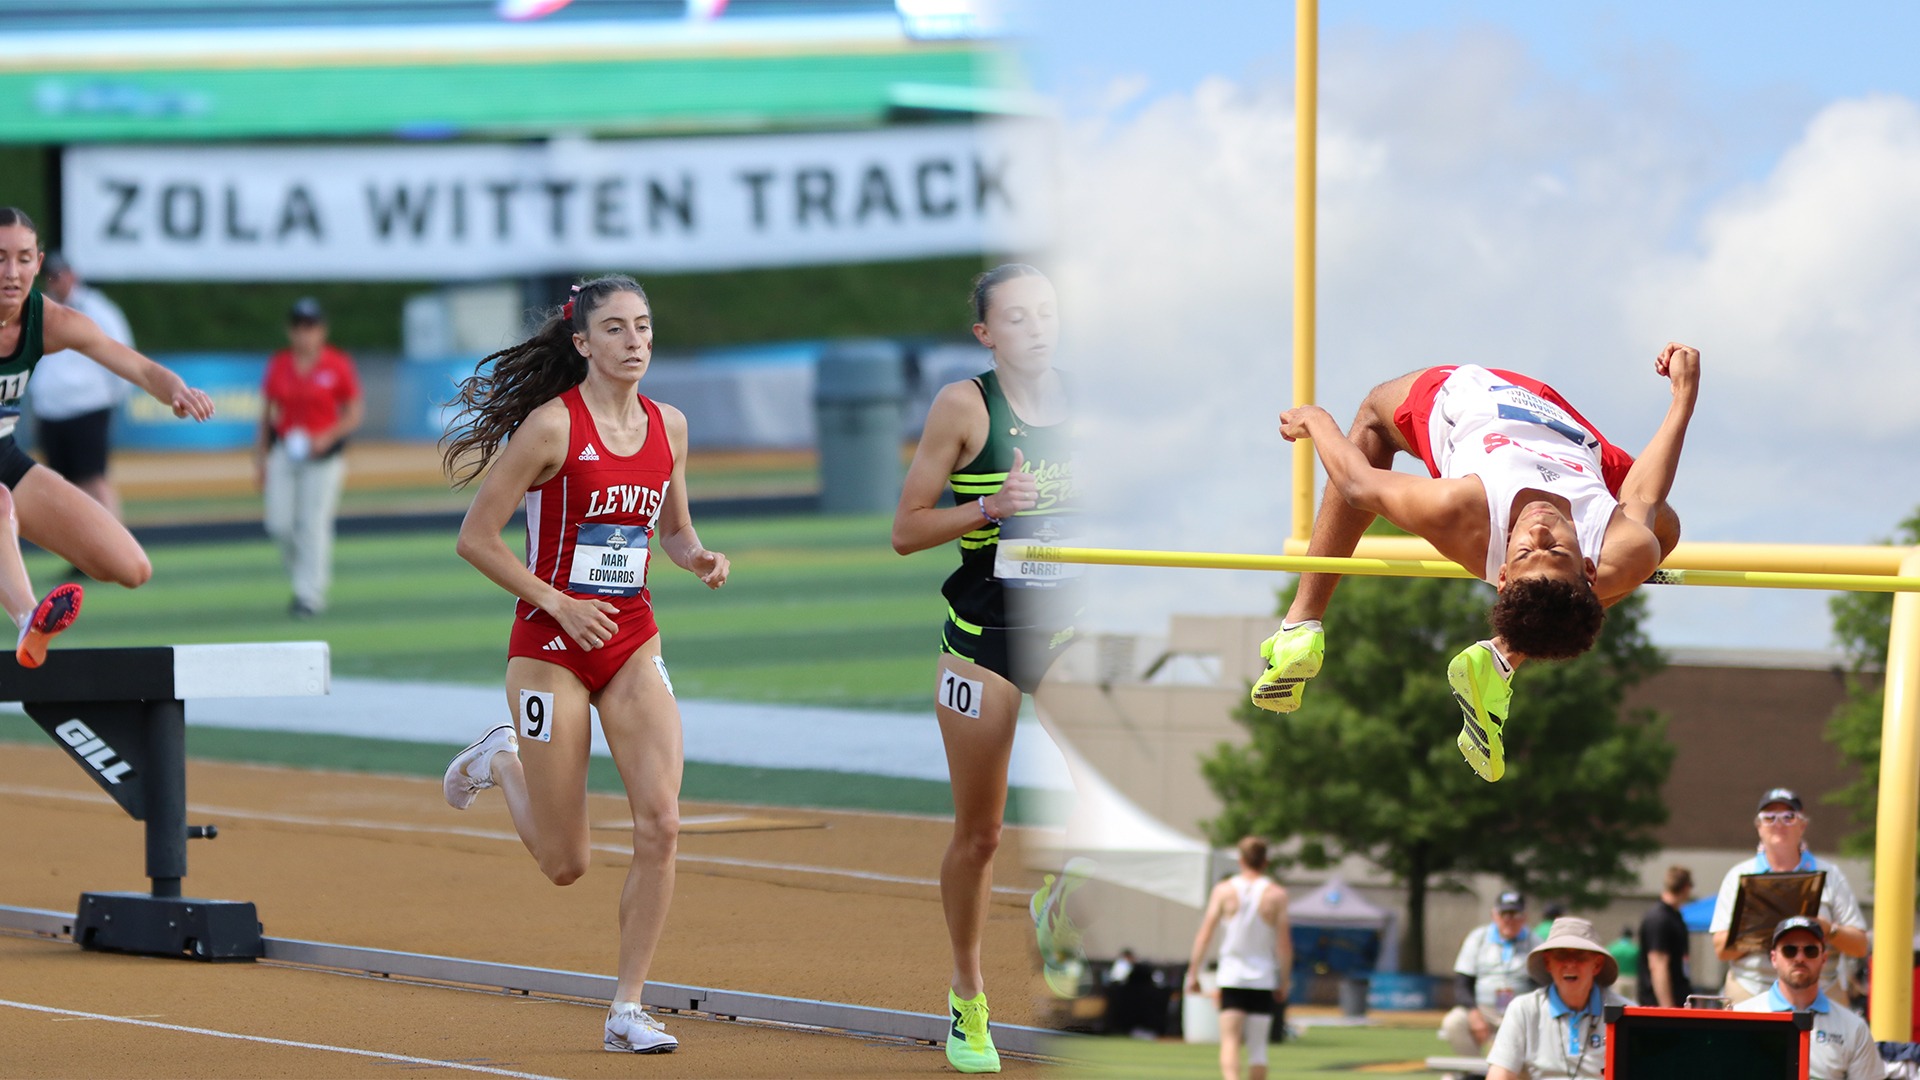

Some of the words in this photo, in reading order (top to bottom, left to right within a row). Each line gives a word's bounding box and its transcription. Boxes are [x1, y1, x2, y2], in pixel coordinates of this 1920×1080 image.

[104, 177, 325, 242] ZOLA
[367, 172, 697, 243] WITTEN
[736, 152, 1016, 231] TRACK
[0, 377, 20, 400] 11
[584, 484, 661, 519] LEWIS
[588, 568, 635, 584] EDWARDS
[601, 553, 629, 568] MARY
[946, 676, 972, 713] 10
[526, 695, 545, 738] 9
[55, 718, 132, 785] GILL
